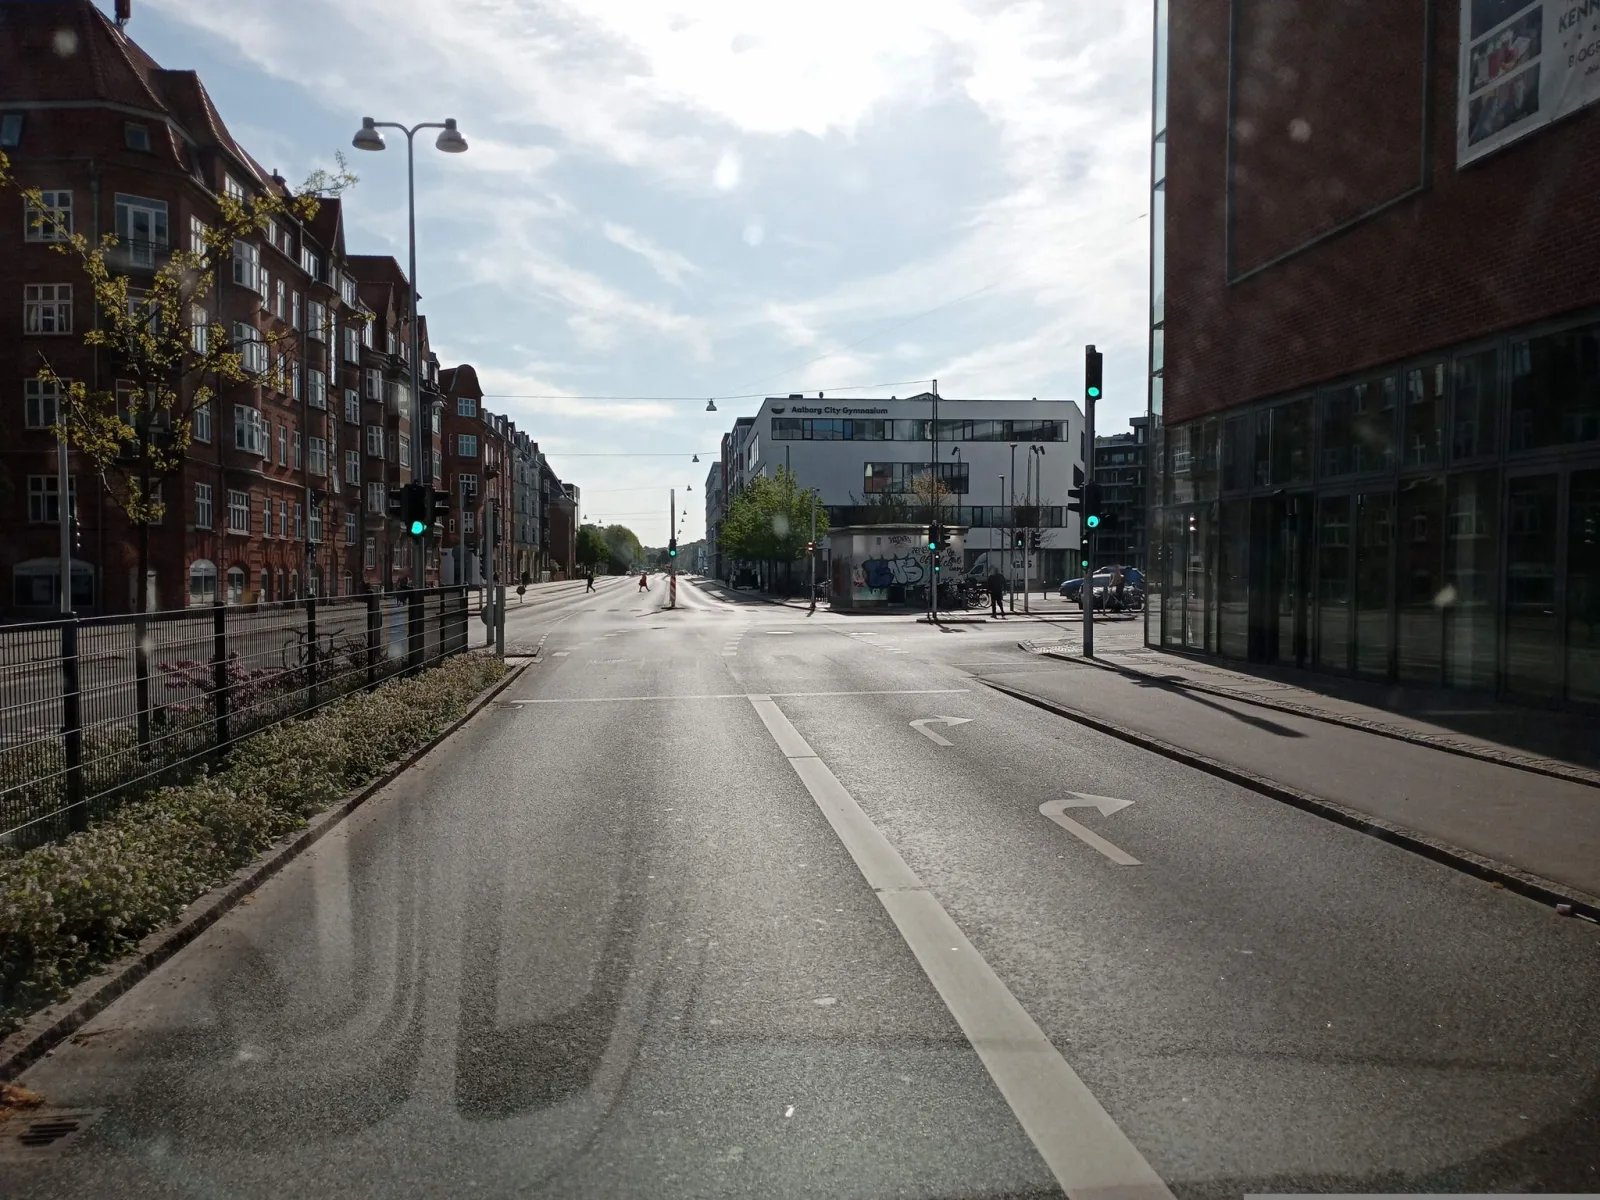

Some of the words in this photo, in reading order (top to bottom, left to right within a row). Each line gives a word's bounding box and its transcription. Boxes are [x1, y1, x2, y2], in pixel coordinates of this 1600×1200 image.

[791, 406, 822, 415] Aalborg
[824, 406, 841, 415] City
[842, 406, 888, 415] Gymnasium
